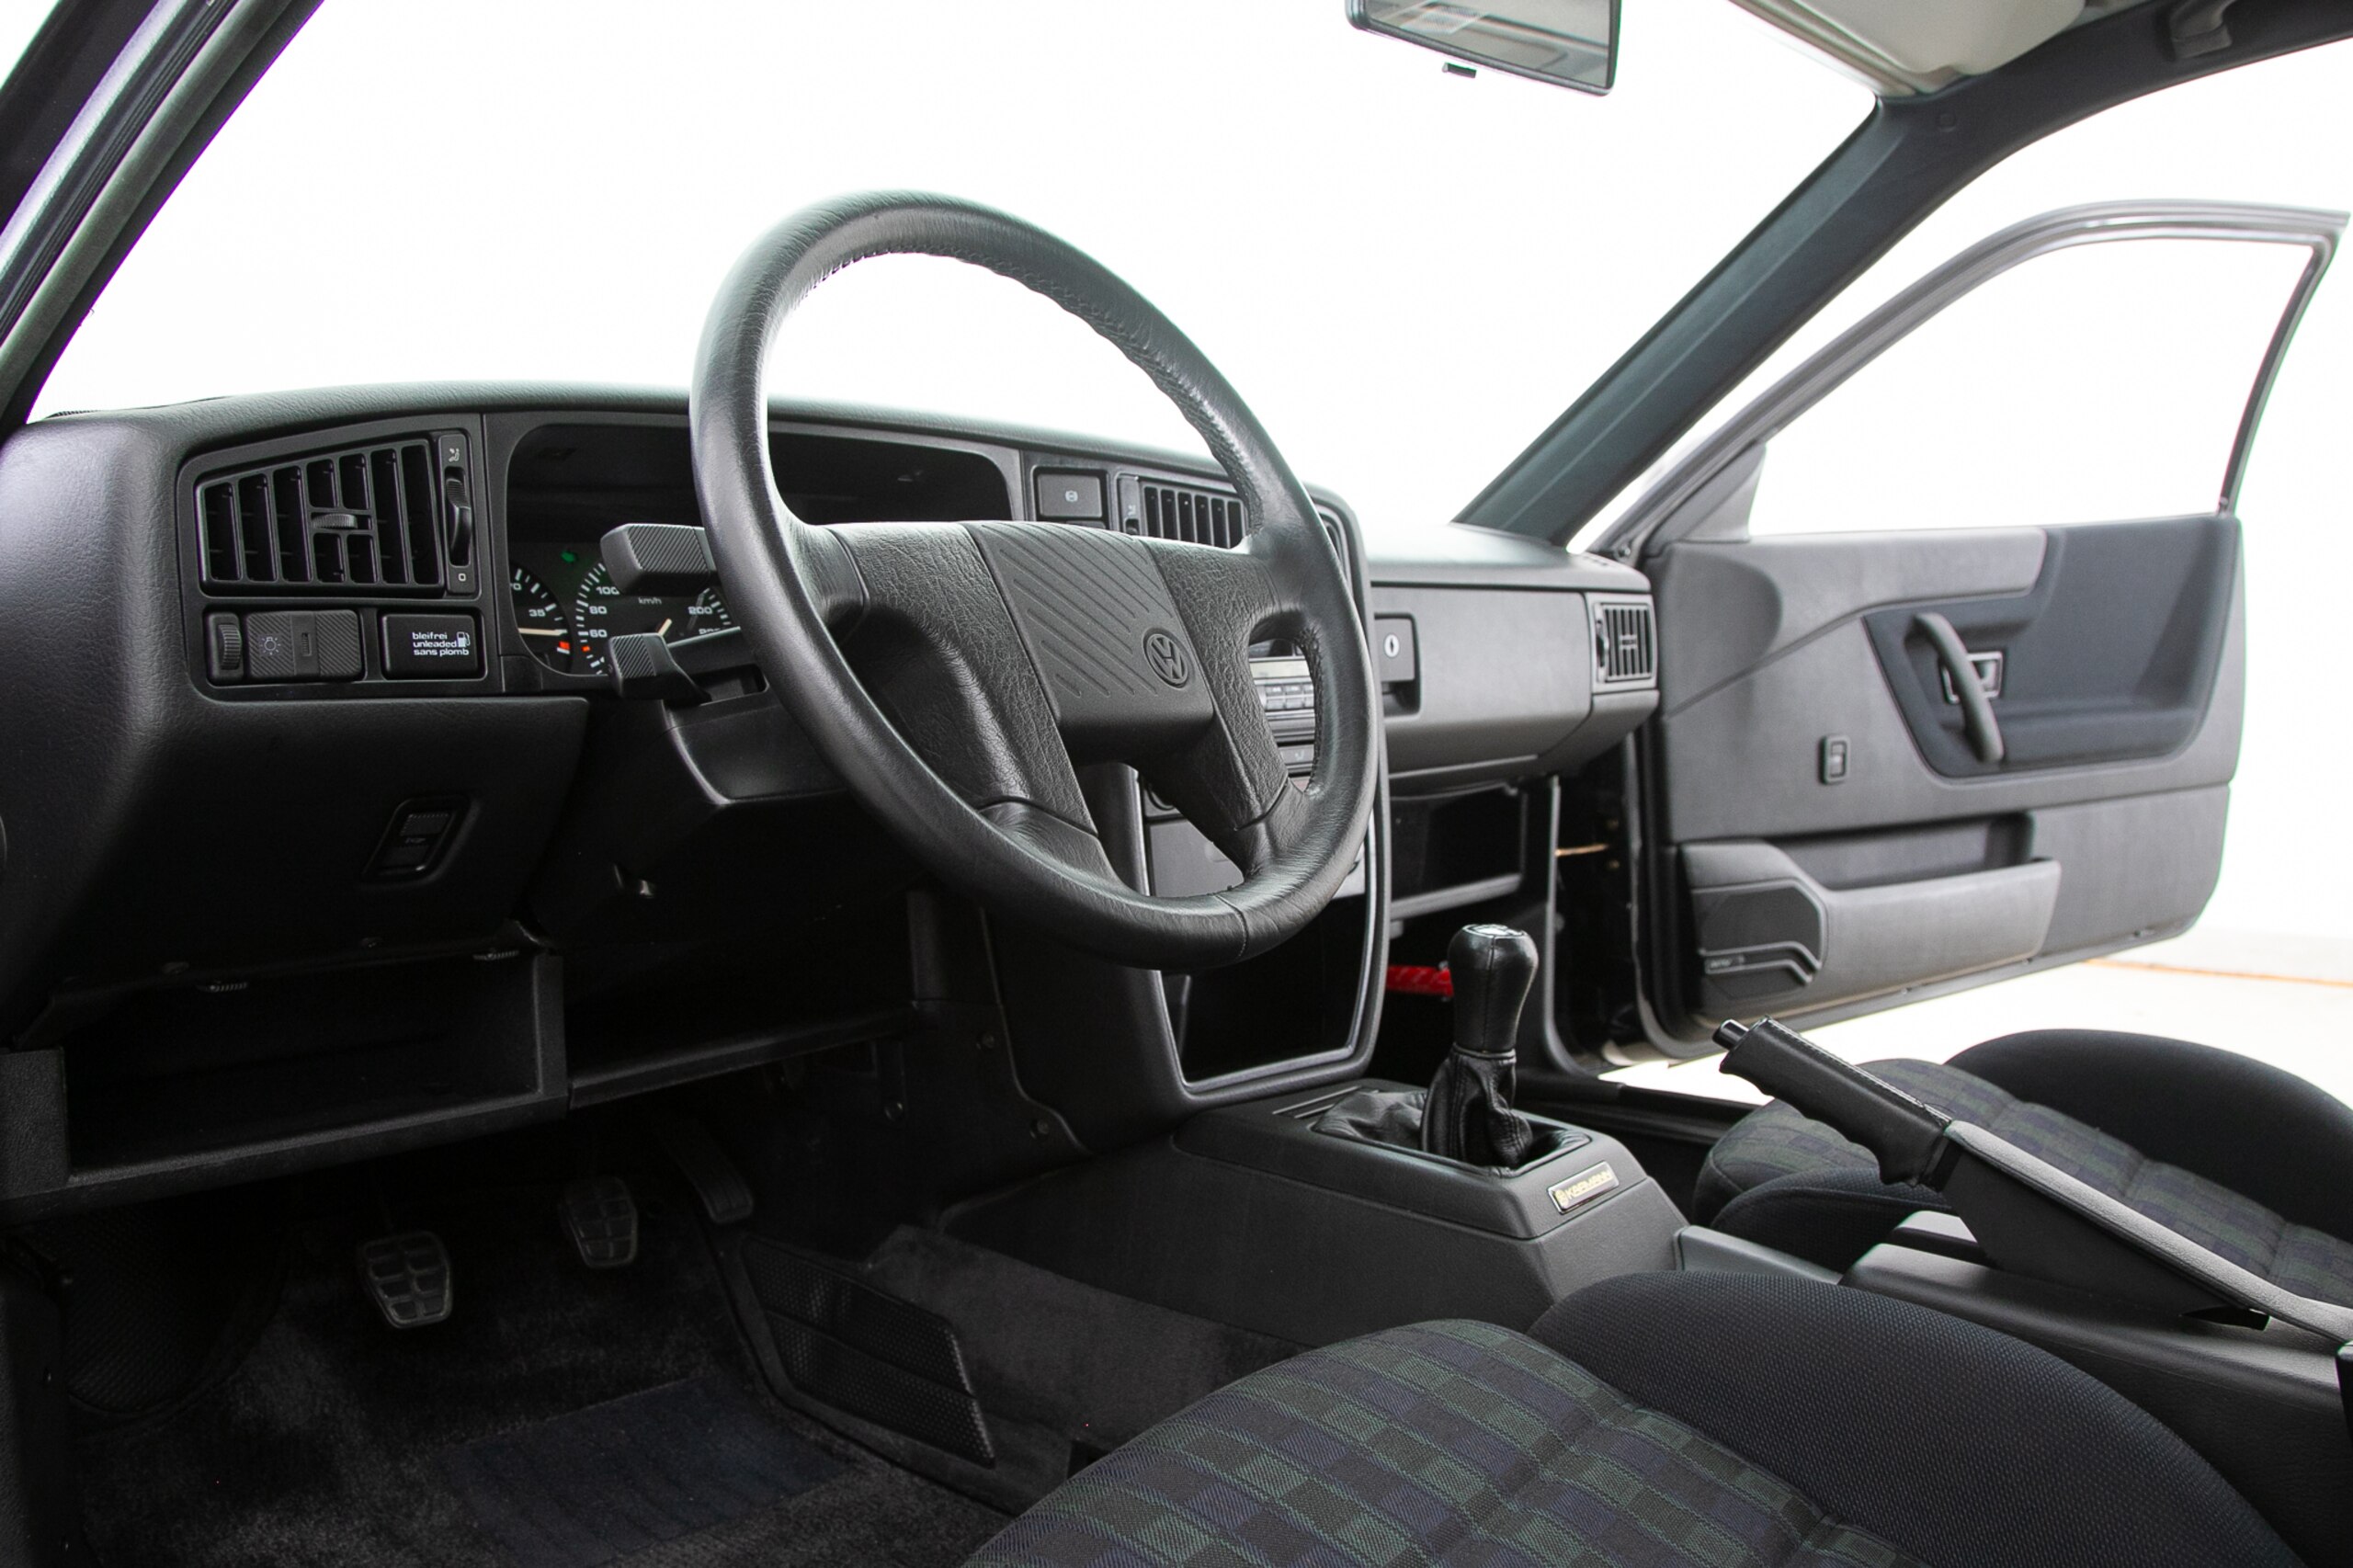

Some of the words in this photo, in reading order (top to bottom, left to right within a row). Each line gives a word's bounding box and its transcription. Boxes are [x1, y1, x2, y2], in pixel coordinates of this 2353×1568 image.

[596, 586, 620, 596] 100
[638, 597, 662, 605] km/h
[529, 608, 546, 618] 35
[589, 606, 608, 615] 80
[688, 607, 713, 615] 200
[412, 631, 448, 640] bleifrei
[589, 629, 608, 638] 60
[439, 648, 470, 657] plomb
